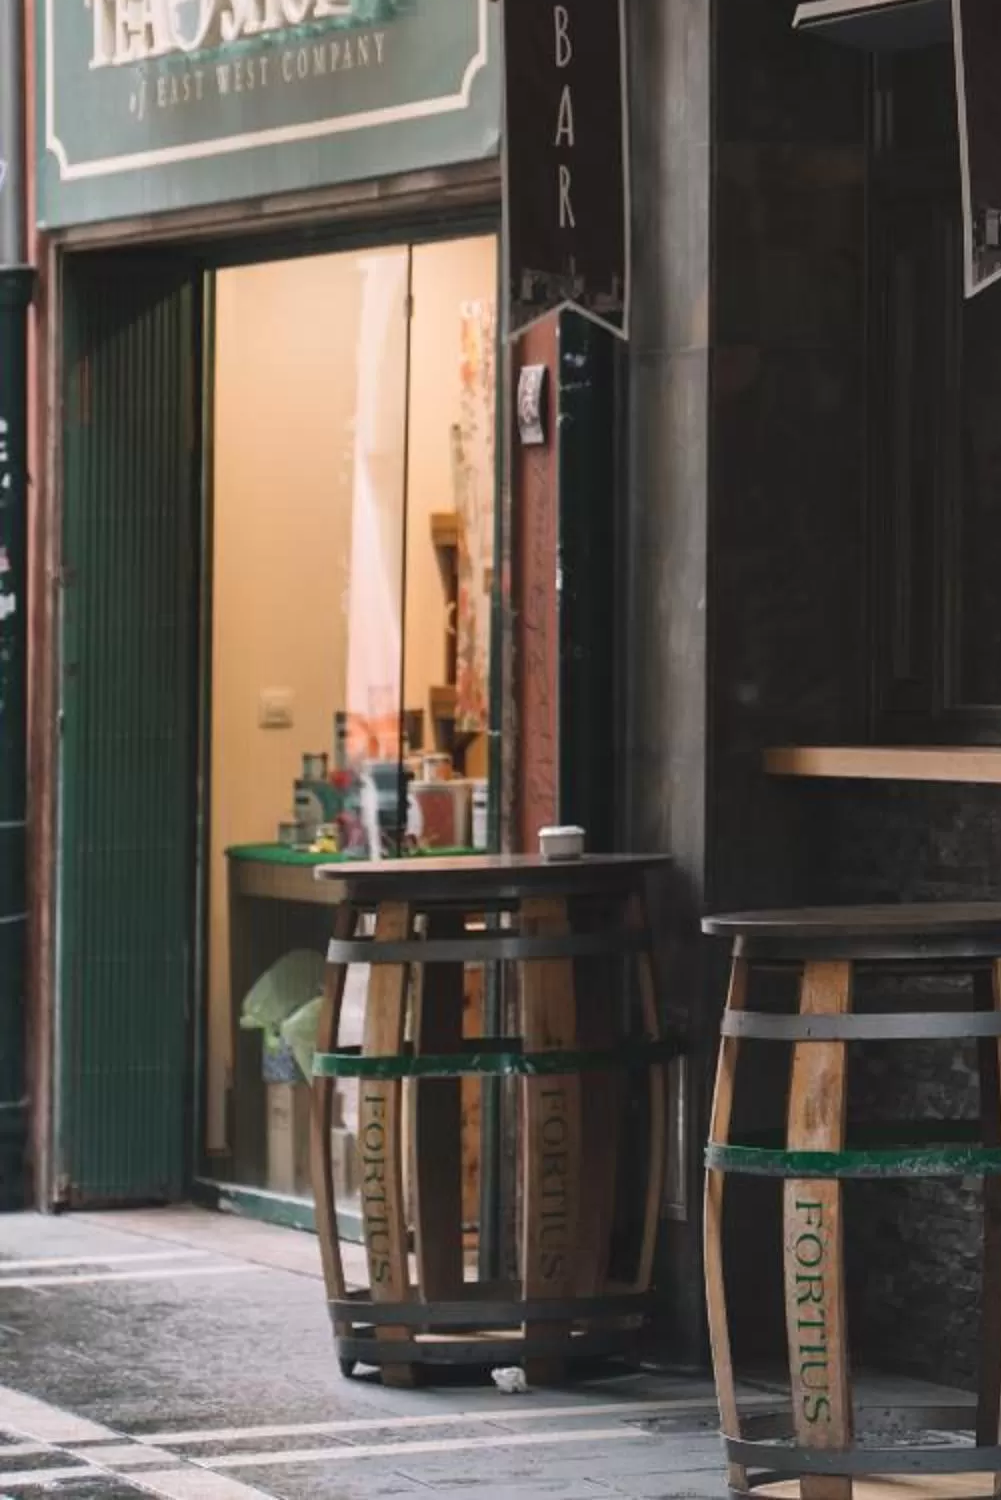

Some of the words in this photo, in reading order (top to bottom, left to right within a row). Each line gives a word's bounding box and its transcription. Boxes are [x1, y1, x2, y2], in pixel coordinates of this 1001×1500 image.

[156, 71, 205, 108] EAST
[215, 57, 269, 96] WEST
[281, 32, 387, 84] COMPANY
[553, 5, 576, 229] BAR
[363, 1095, 392, 1285] FORTIUS
[539, 1088, 567, 1281] FORTIUS
[791, 1199, 832, 1427] FORTIUS
